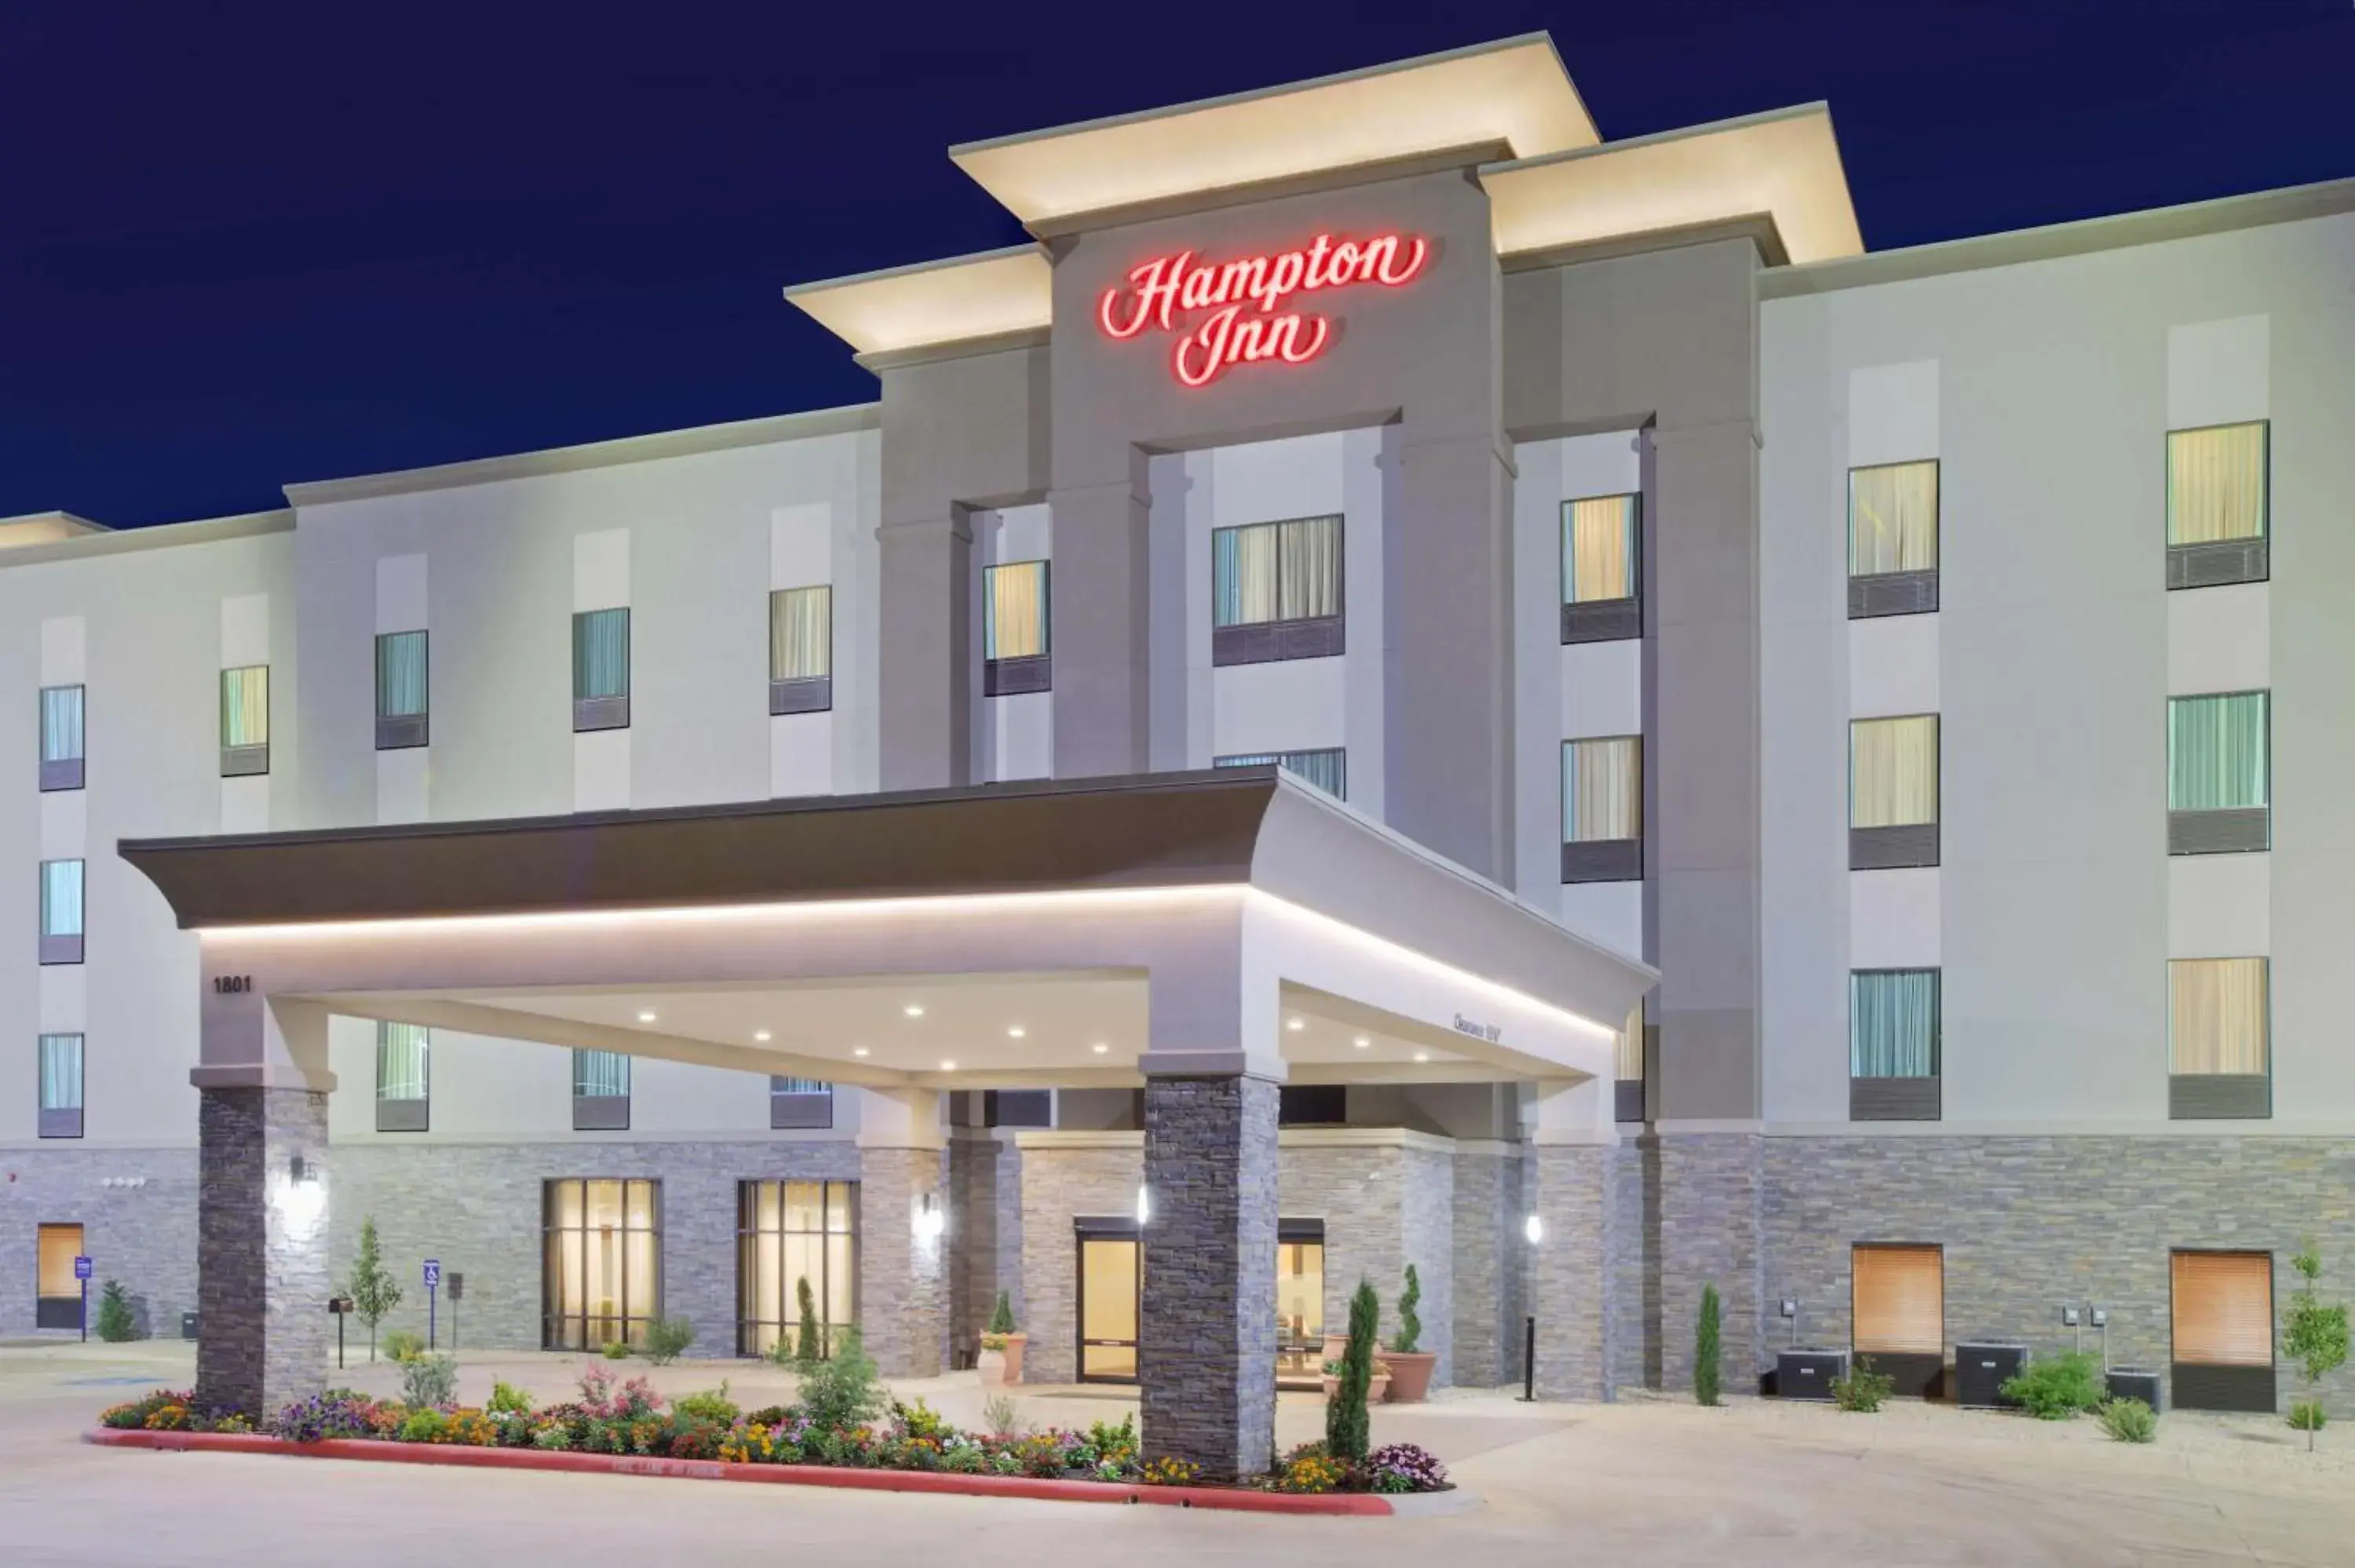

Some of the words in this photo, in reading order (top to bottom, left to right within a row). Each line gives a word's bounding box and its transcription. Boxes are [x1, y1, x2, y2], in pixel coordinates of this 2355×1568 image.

[1101, 234, 1426, 337] Hampton
[1177, 305, 1327, 385] Inn
[214, 975, 250, 993] 1801
